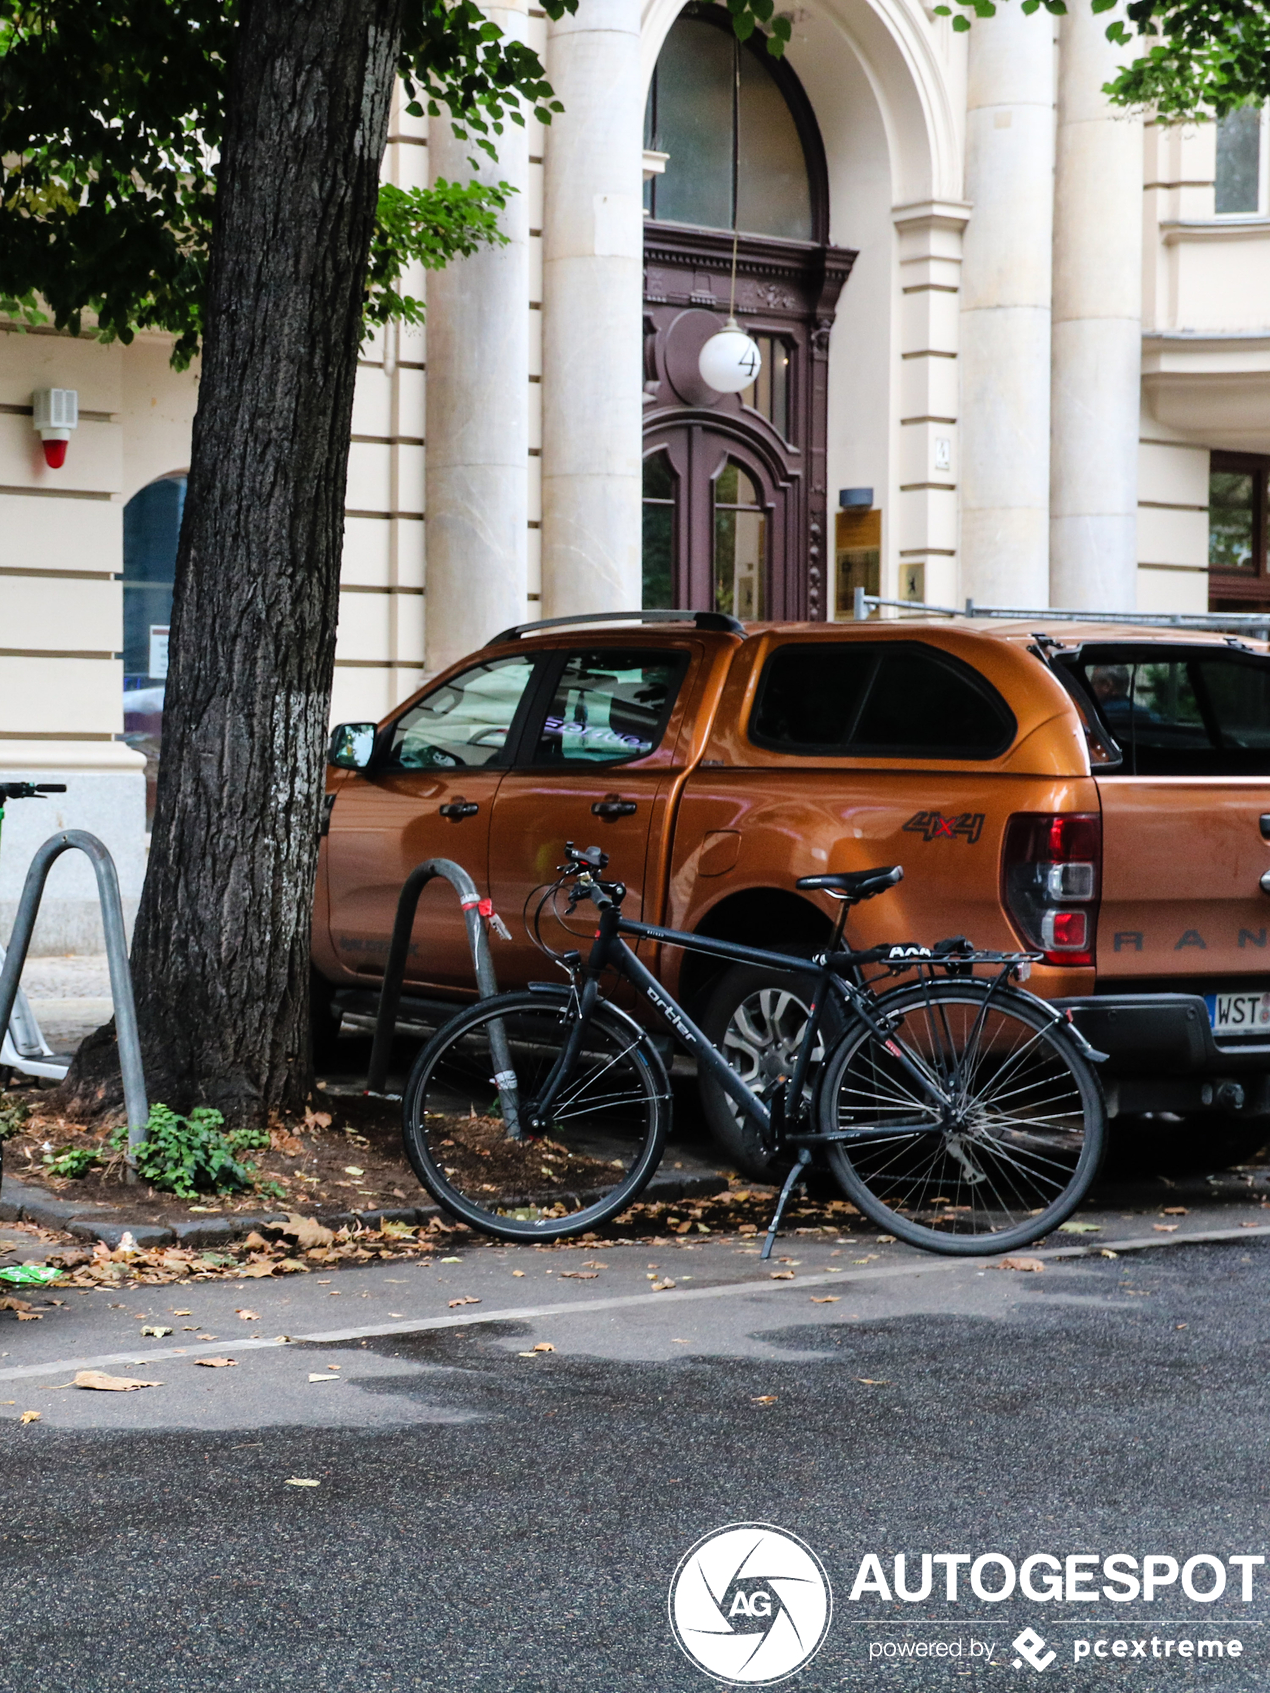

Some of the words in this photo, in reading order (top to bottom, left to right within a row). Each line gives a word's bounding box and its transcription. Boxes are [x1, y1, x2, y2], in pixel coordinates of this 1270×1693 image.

[738, 342, 757, 377] 4
[1113, 928, 1267, 952] RAN
[647, 986, 697, 1043] ortler
[1218, 997, 1261, 1025] WST
